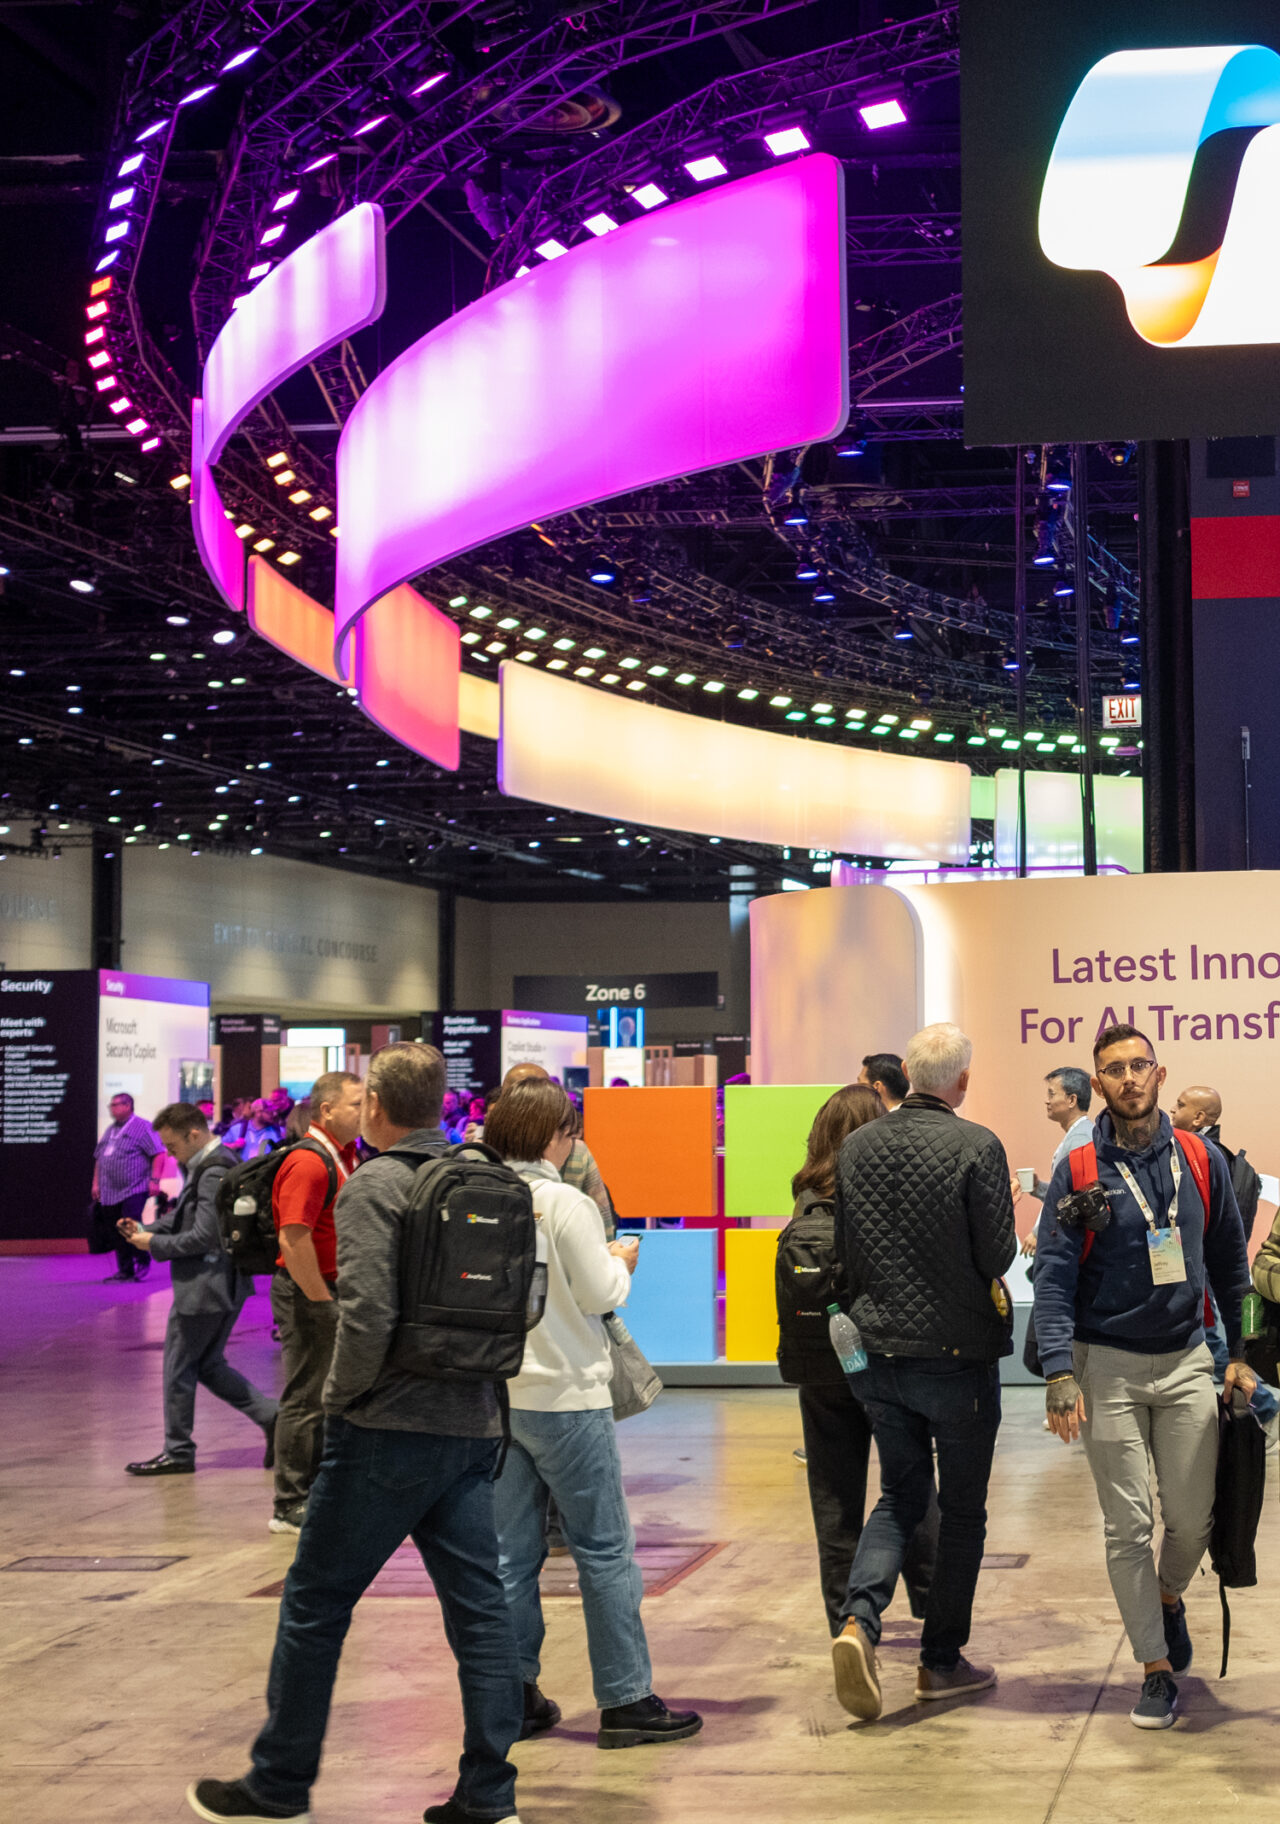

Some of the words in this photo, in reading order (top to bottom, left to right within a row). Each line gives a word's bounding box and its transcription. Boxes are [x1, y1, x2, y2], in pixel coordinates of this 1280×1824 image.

[1109, 698, 1136, 718] EXIT
[1052, 947, 1176, 984] Latest
[0, 978, 53, 994] Security
[585, 984, 630, 1000] Zone
[634, 983, 646, 1000] 6
[106, 1019, 138, 1035] Microsoft
[1020, 1008, 1083, 1043] For
[1096, 1006, 1135, 1042] AI
[106, 1044, 132, 1062] Security
[134, 1047, 157, 1063] Copilot
